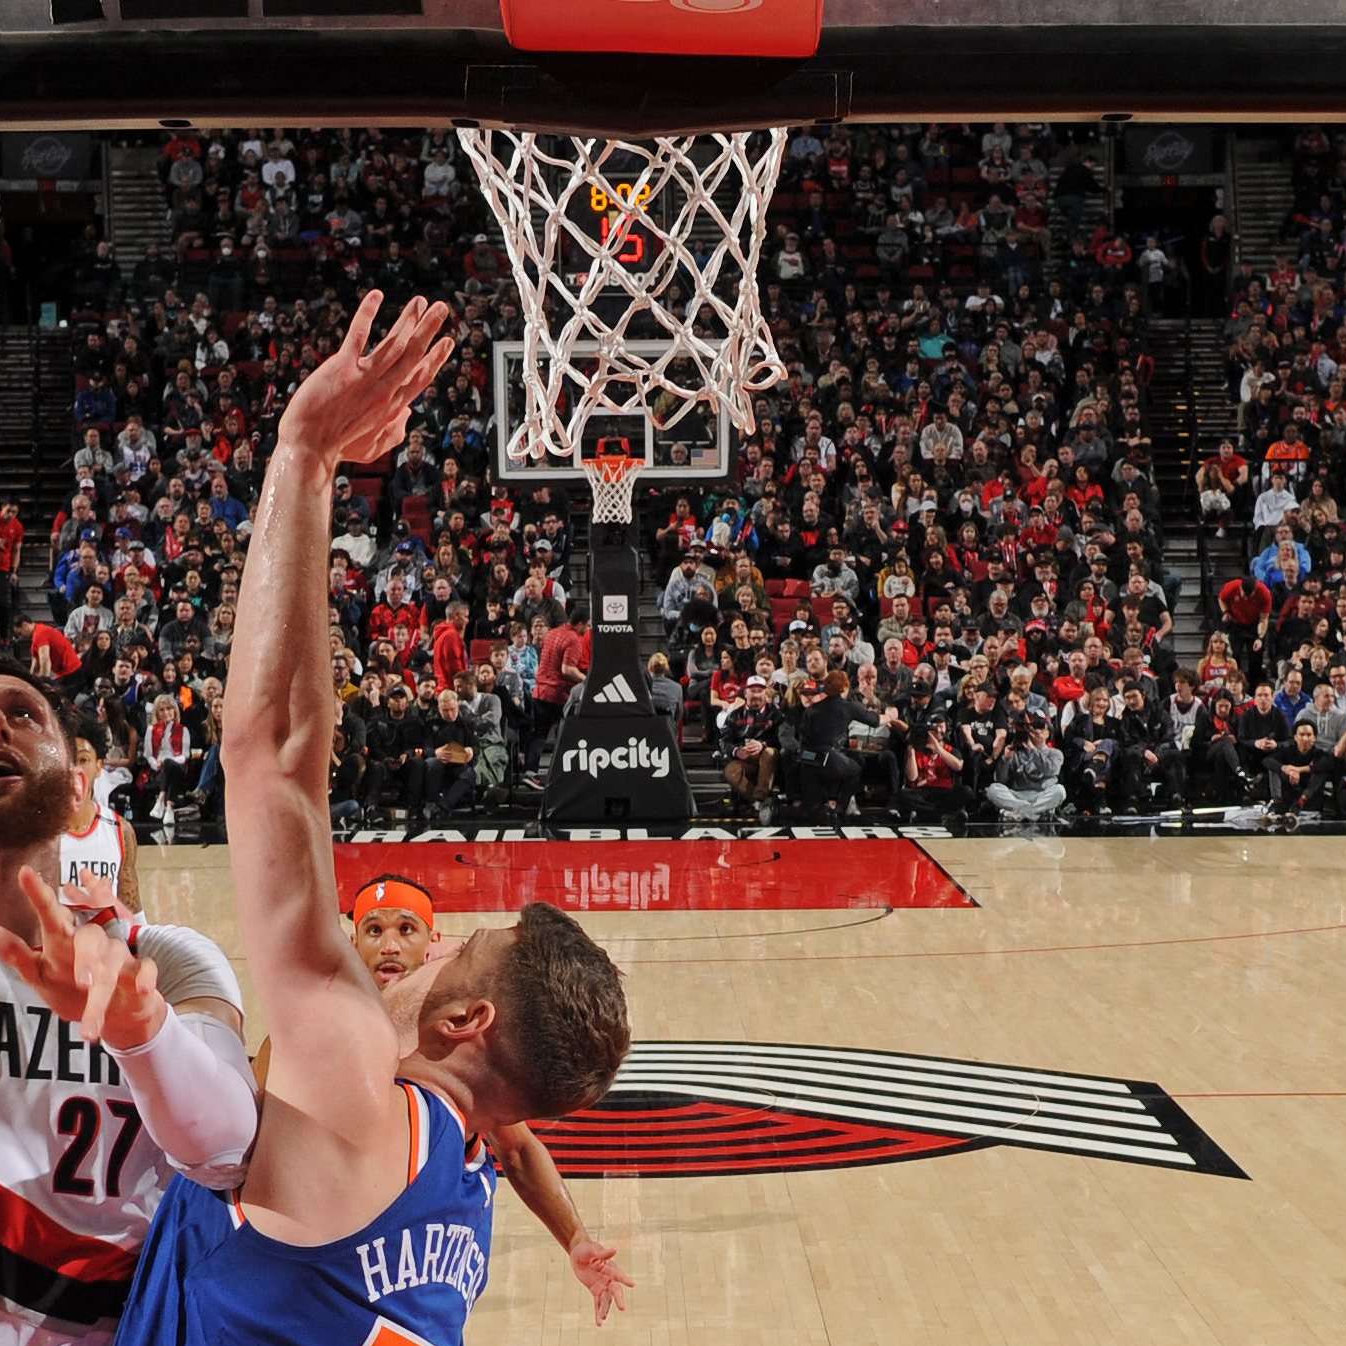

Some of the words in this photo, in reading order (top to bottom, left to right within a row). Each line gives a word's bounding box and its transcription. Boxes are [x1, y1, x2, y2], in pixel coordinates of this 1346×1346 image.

[597, 624, 634, 634] TOYOTA
[562, 736, 670, 779] ripcity
[568, 826, 954, 842] BLAZERS
[53, 1095, 144, 1198] 27
